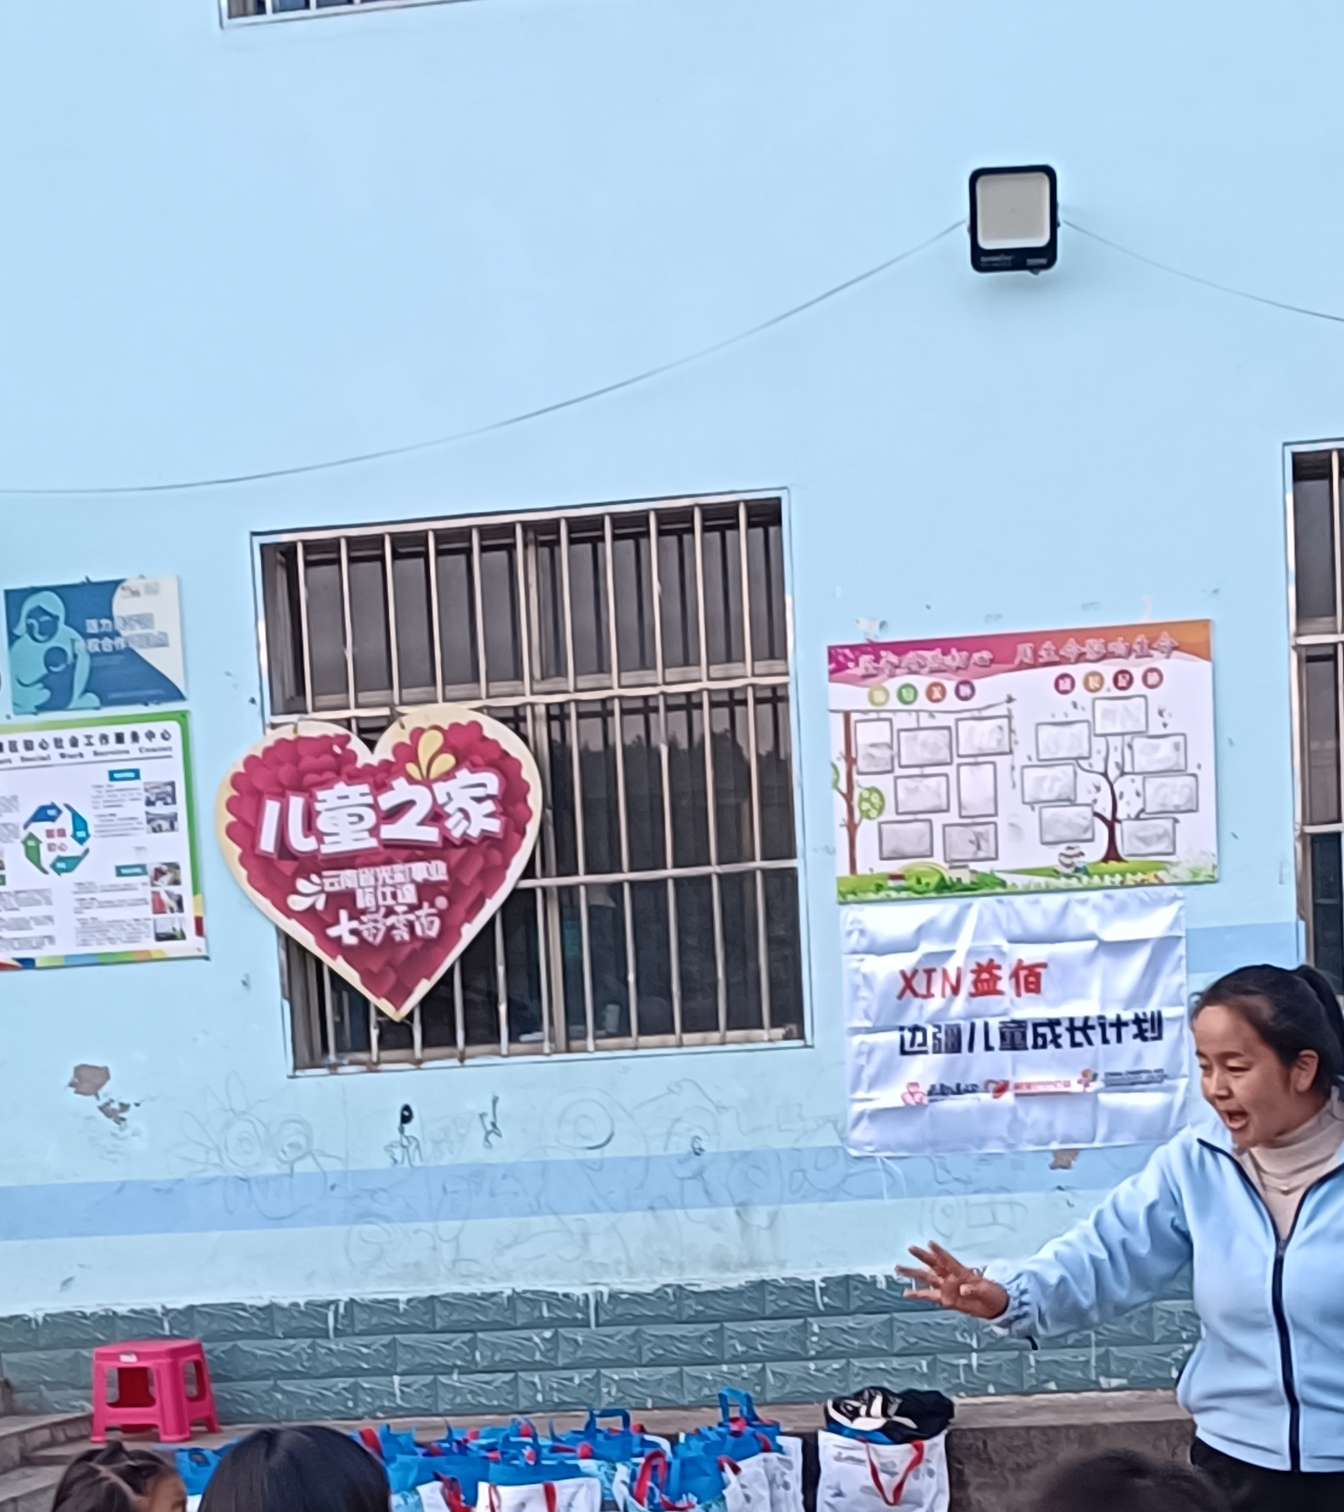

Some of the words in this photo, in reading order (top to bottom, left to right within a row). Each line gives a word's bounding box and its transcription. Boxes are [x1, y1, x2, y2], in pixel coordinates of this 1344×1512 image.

[258, 767, 504, 853] 儿童之家
[896, 957, 1049, 1001] XIN益佰
[898, 1009, 1164, 1057] 边疆儿童成长计划
